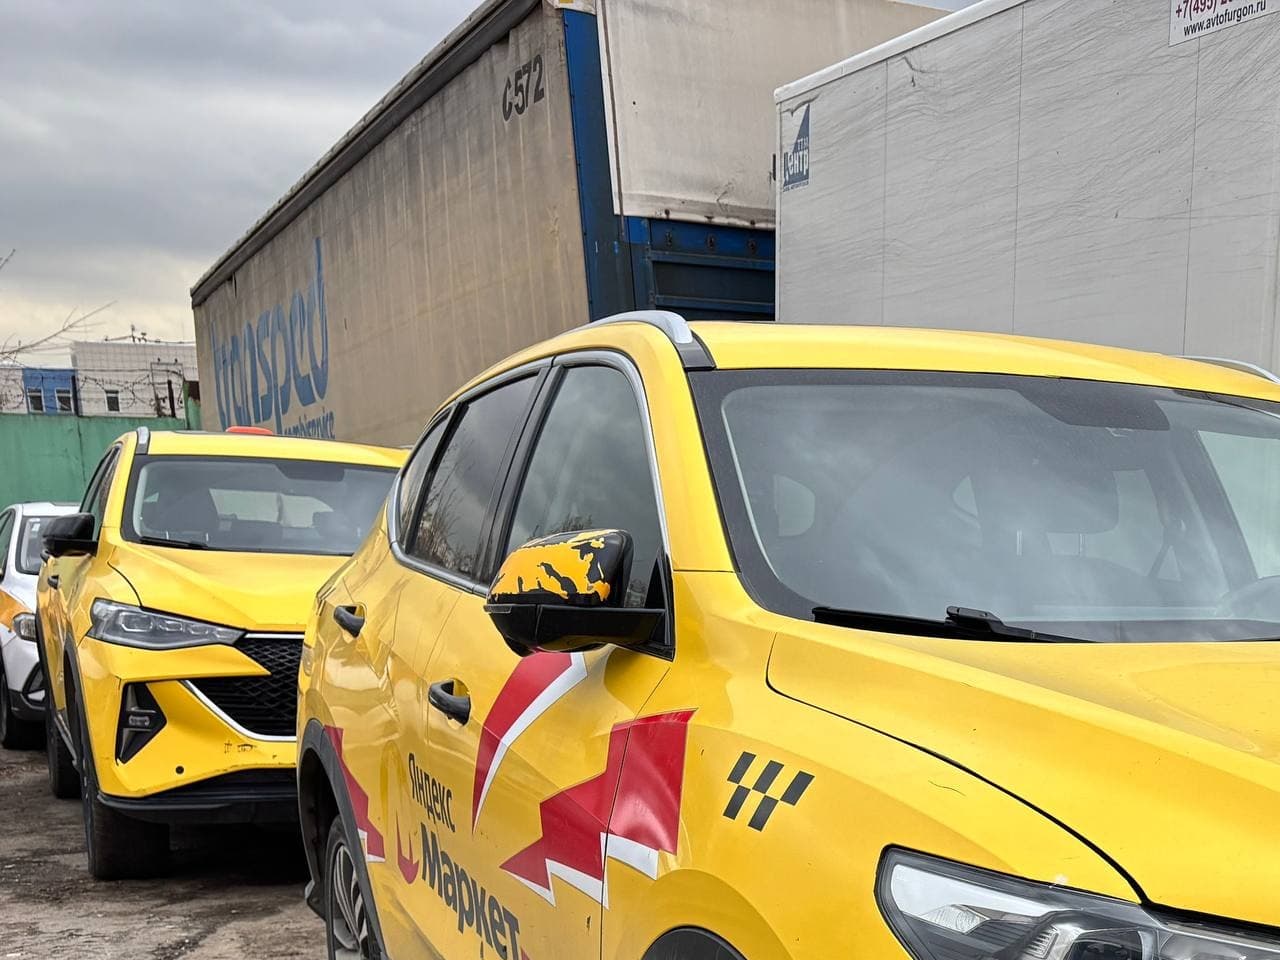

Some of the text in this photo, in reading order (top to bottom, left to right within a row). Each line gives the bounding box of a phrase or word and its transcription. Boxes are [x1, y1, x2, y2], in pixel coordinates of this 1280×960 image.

[1183, 0, 1266, 36] www.avtofurgon.ru
[503, 54, 545, 122] C572
[211, 236, 329, 436] transped
[408, 752, 456, 833] Яндекс
